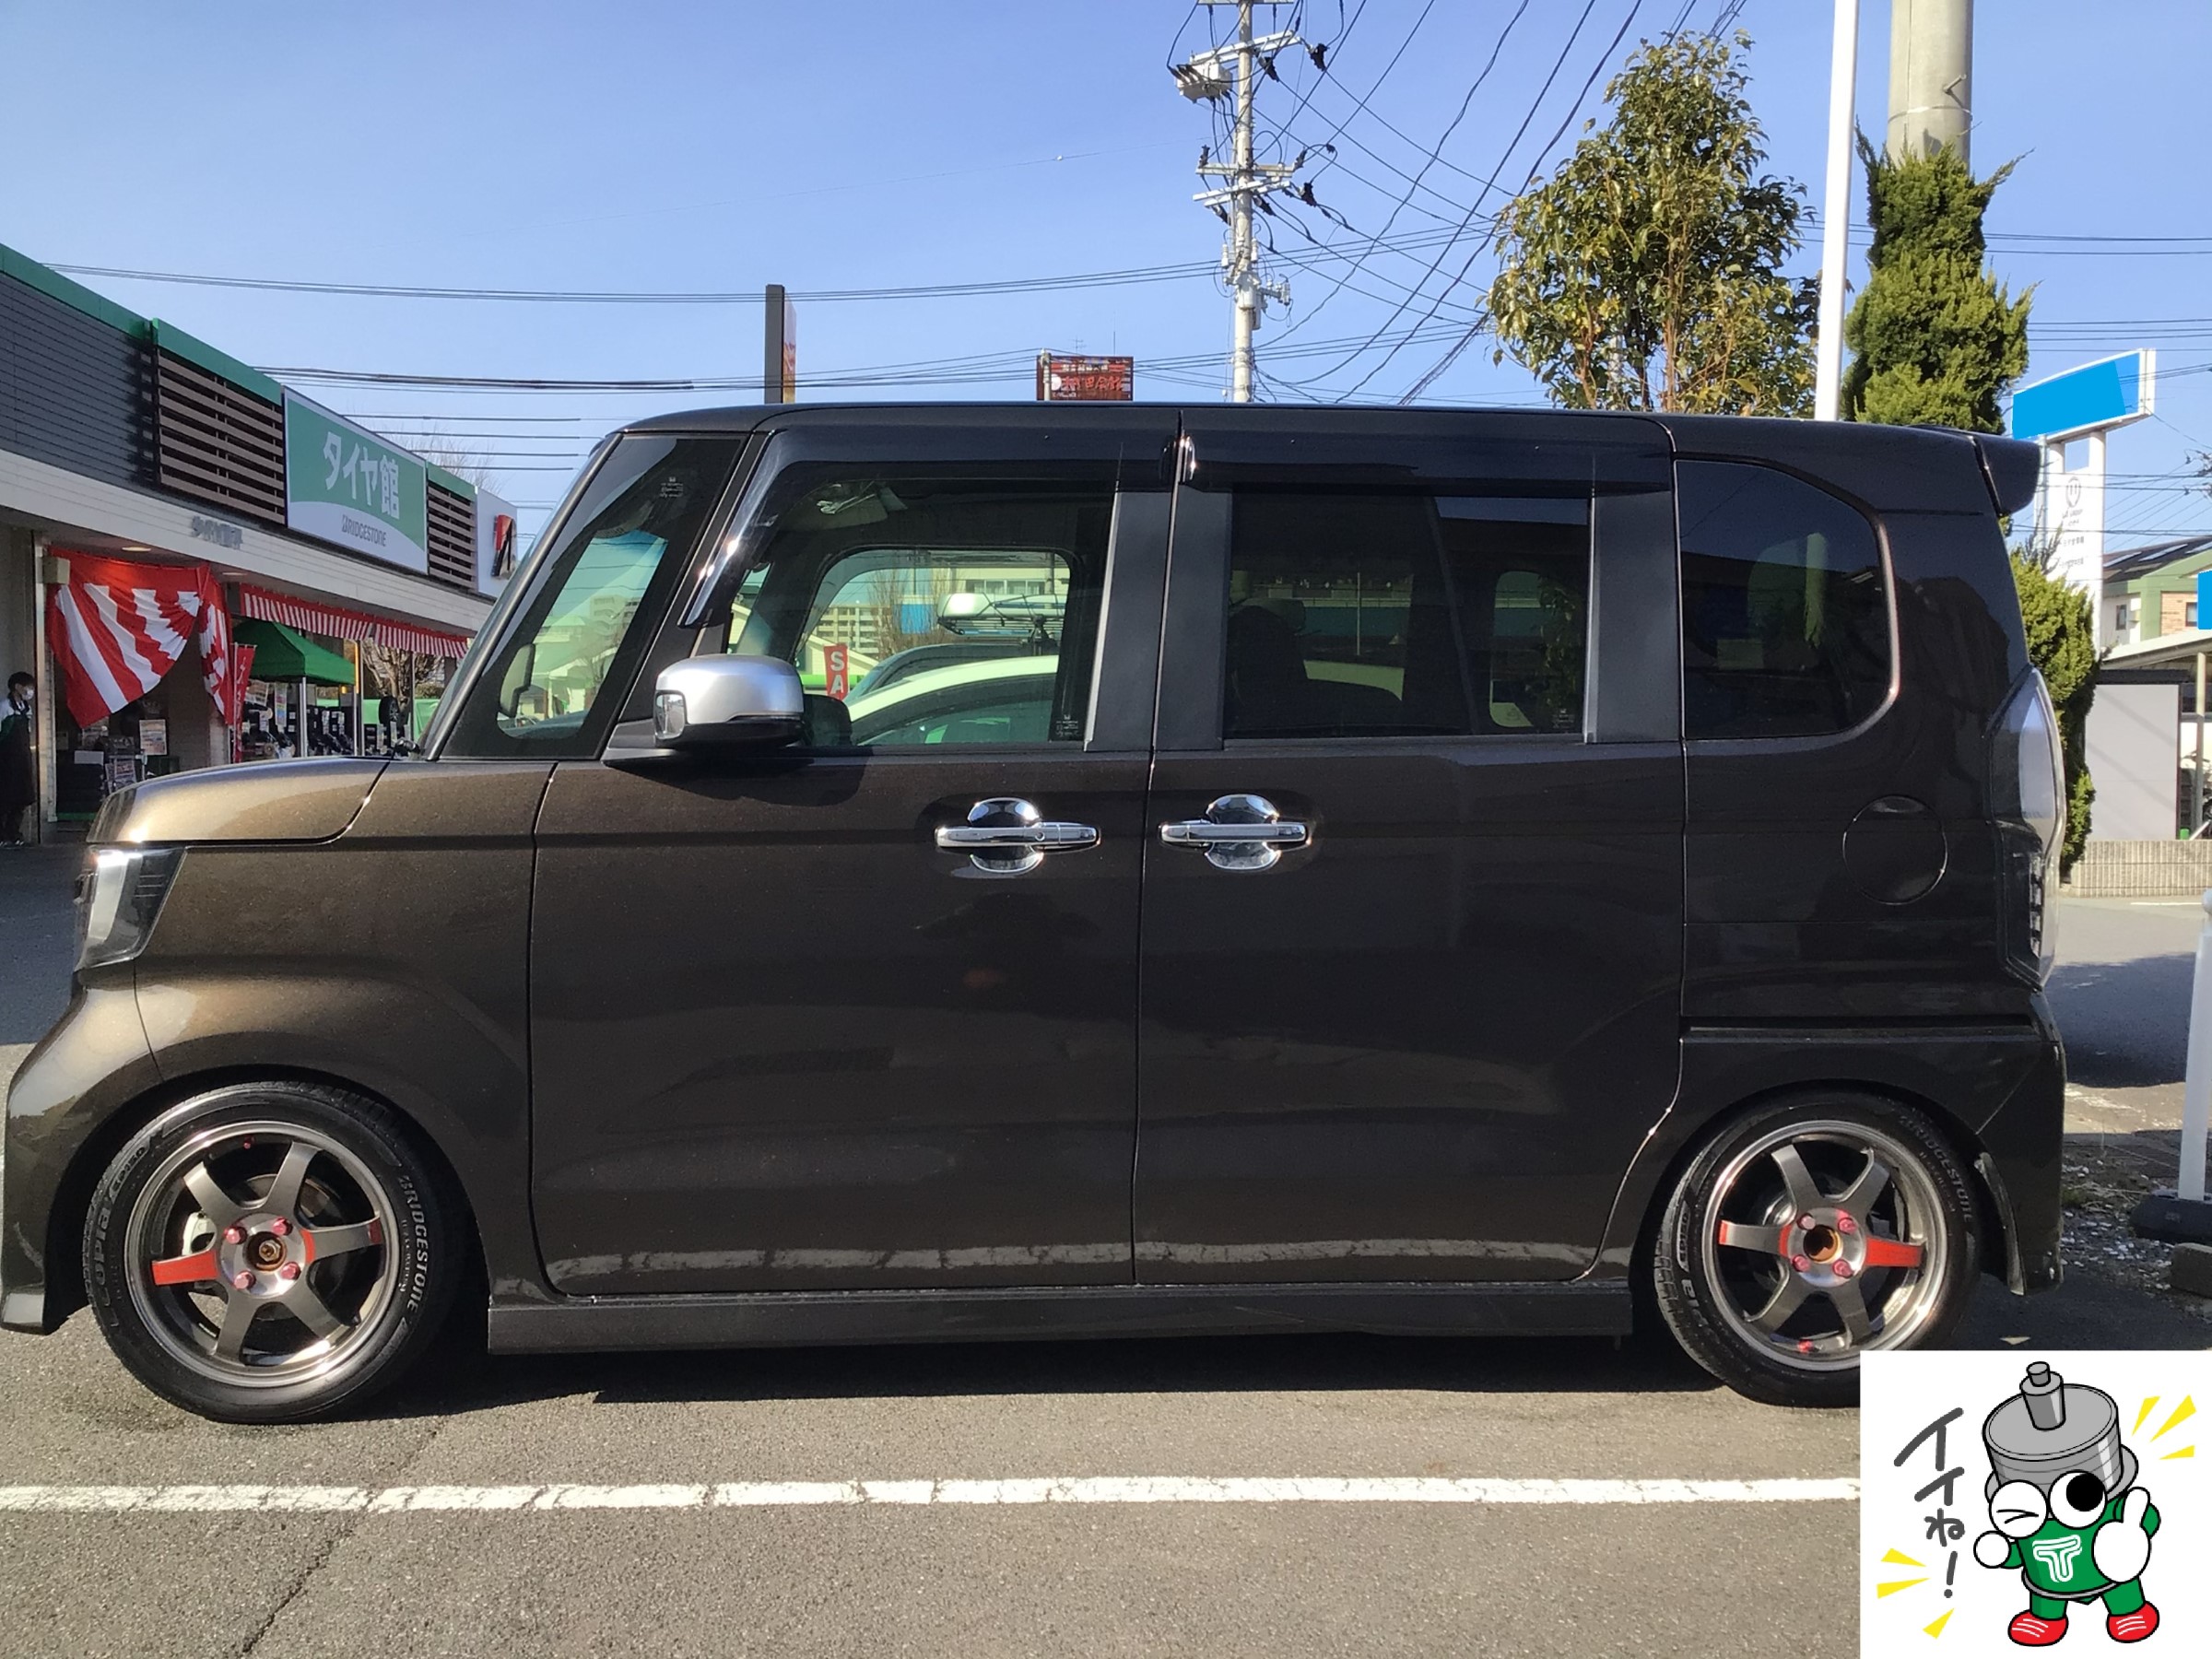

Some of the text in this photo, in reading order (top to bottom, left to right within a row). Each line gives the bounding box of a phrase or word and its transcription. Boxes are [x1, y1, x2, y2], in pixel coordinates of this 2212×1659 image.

[324, 430, 400, 520] タイヤ館
[341, 513, 387, 547] BRIDGESTONE
[398, 1174, 429, 1312] BRIDGESTONE
